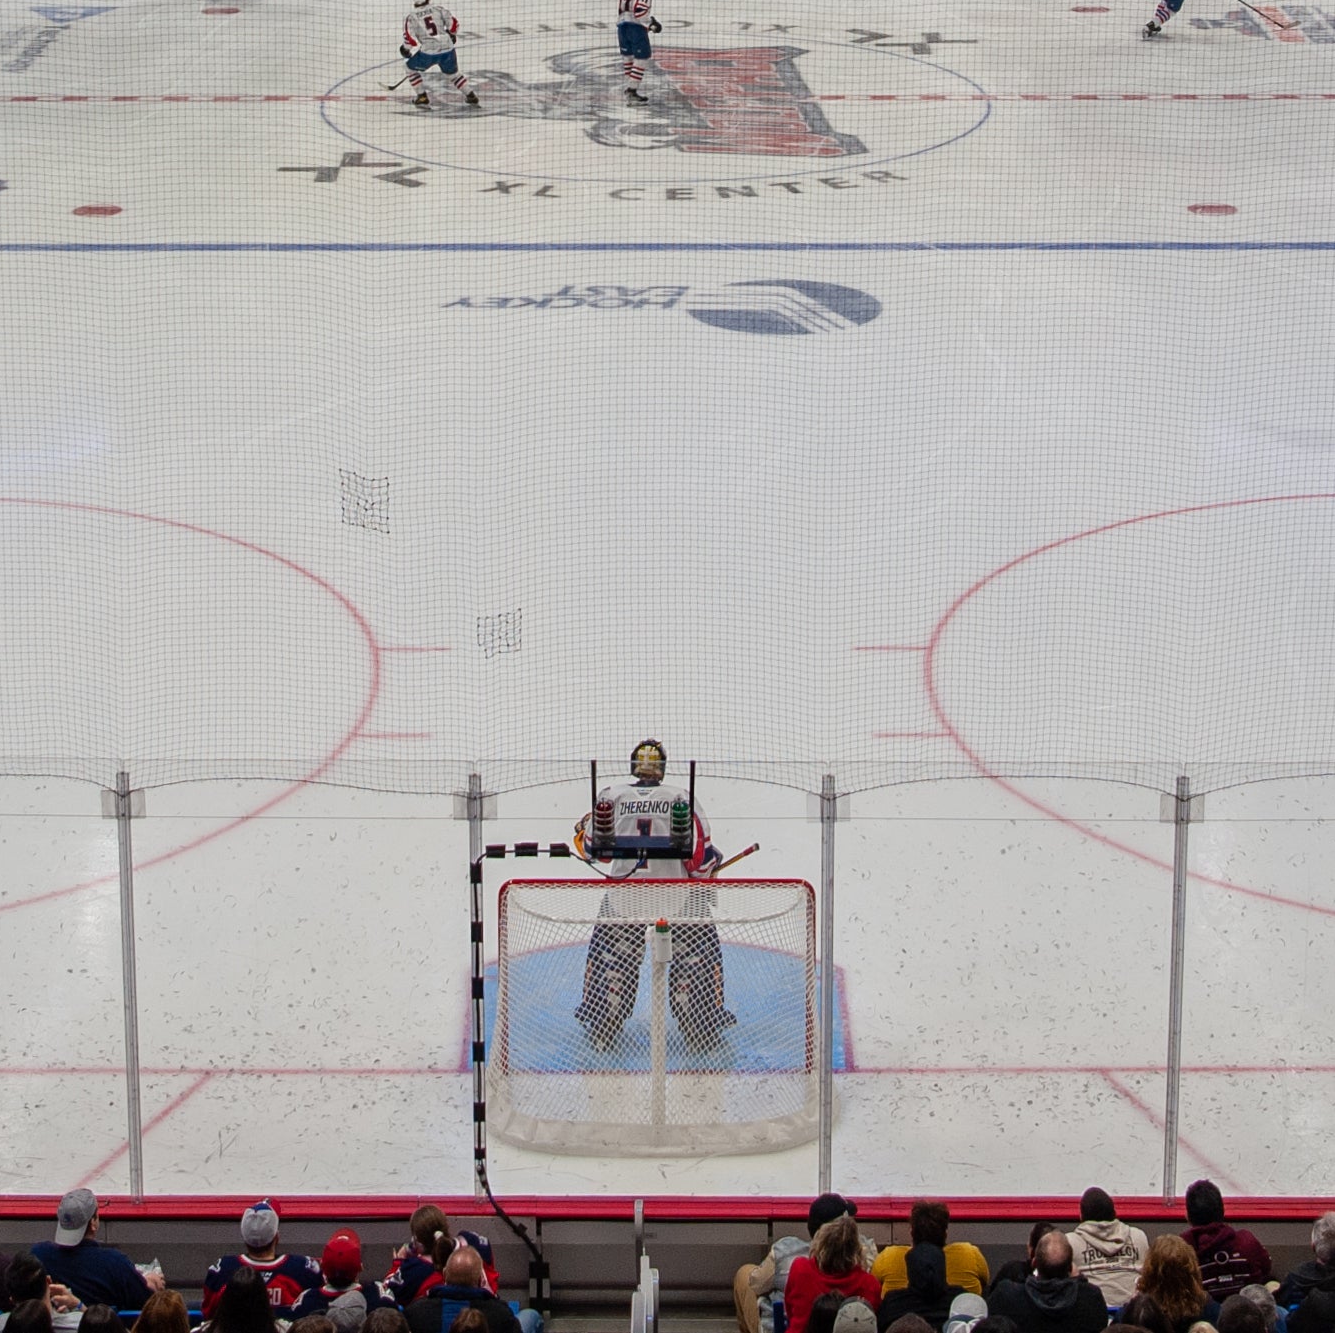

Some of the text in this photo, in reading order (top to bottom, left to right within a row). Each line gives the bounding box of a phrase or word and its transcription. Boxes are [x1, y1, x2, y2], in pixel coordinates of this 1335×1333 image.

[424, 16, 438, 37] 5
[484, 168, 909, 203] XL CENTER
